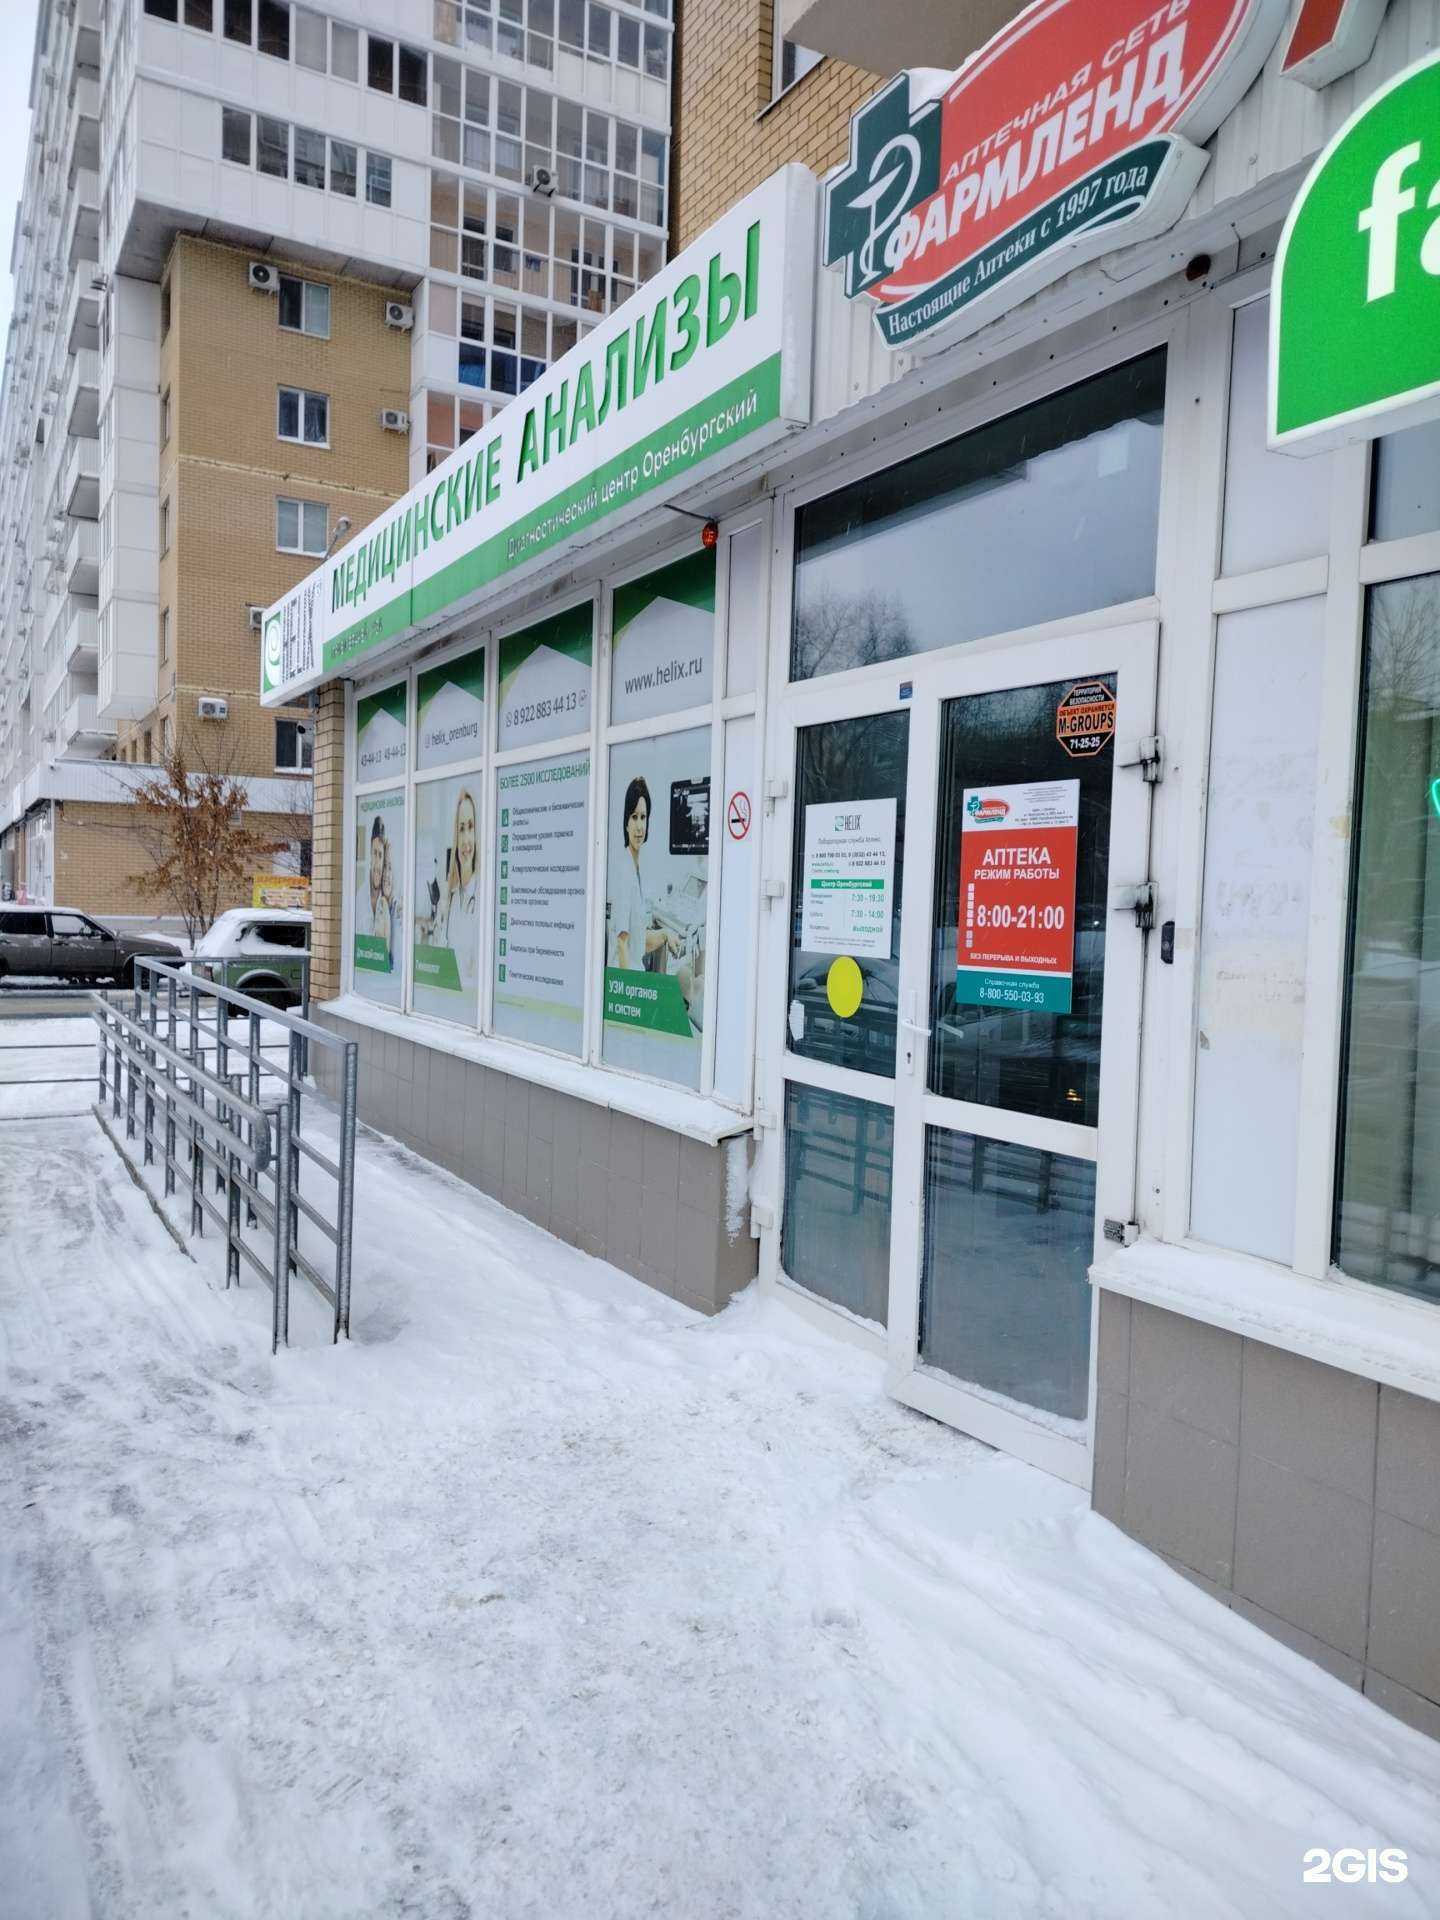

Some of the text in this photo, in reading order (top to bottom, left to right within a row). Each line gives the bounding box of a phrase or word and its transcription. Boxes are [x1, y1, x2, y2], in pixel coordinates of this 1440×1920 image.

[943, 60, 1091, 185] АПТЕЧНАЯ
[1101, 0, 1192, 71] СЕТЬ
[884, 20, 1189, 273] ФАРМЛЕНД
[888, 164, 1149, 337] Настоящие Аптеки с 1997 года
[331, 219, 761, 615] МЕДИЦИНСКИЕ АНАЛИЗЫ
[507, 388, 758, 560] Диагностический центр Оренбургский
[624, 656, 703, 695] www.helix.ru
[513, 693, 577, 726] 8 922 883 44 13
[431, 720, 478, 746] helix_orenburg
[1058, 711, 1114, 734] M-GROUPS
[1069, 736, 1101, 750] 71-25-25
[500, 760, 591, 790] БОЛЕЕ 2500 ИССЛЕДОВАНИЙ
[844, 814, 861, 831] HELIX
[982, 847, 1052, 866] АПТЕКА
[974, 868, 1060, 880] РЕЖИМ РАБОТЫ
[977, 904, 1065, 930] 8:00-21:00
[982, 953, 1014, 961] ПЕРЕРЫВА
[1020, 955, 1057, 965] ВЫХОДНЫХ
[608, 978, 658, 1002] УЗИ органов
[979, 987, 1045, 1004] 8-800-550-03-93
[984, 978, 1040, 990] Справочная служба
[614, 1002, 641, 1018] систем
